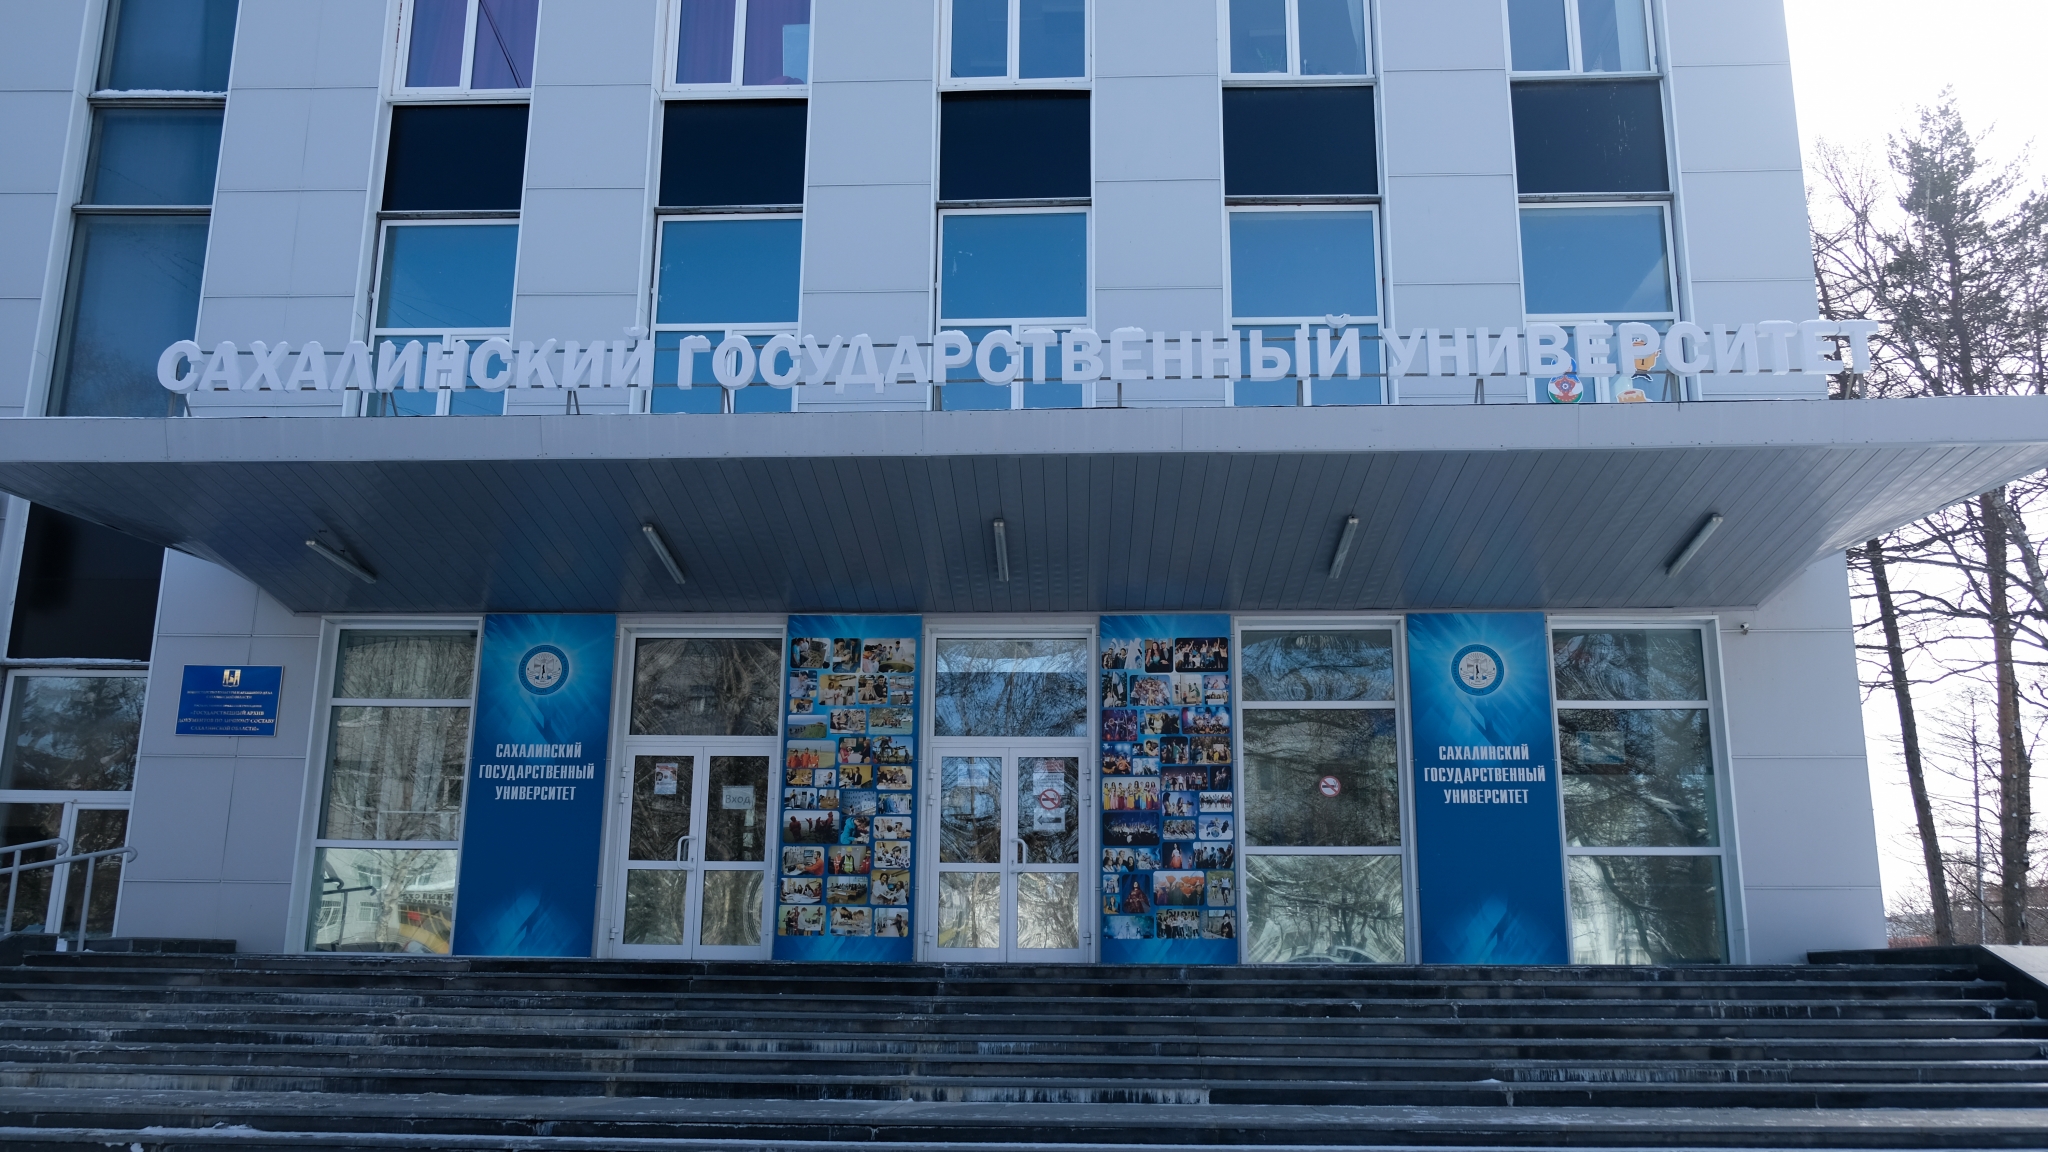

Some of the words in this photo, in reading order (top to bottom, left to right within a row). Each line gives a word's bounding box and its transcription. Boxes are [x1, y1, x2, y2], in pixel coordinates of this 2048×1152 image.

[157, 326, 656, 394] САХАЛИНСКИЙ
[676, 314, 1361, 394] ГОСУДАРСТВЕННЫЙ
[1382, 319, 1878, 379] УНИВЕРСИТЕТ
[496, 742, 582, 758] САХАЛИНСКИЙ
[1438, 744, 1529, 760] САХАЛИНСКИЙ
[479, 763, 594, 781] ГОСУДАРСТВЕННЫЙ
[1424, 765, 1546, 784] ГОСУДАРСТВЕННЫЙ
[495, 786, 576, 801] УНИВЕРСИТЕТ
[725, 794, 751, 805] Вход
[1444, 789, 1529, 804] УНИВЕРСИТЕТ
